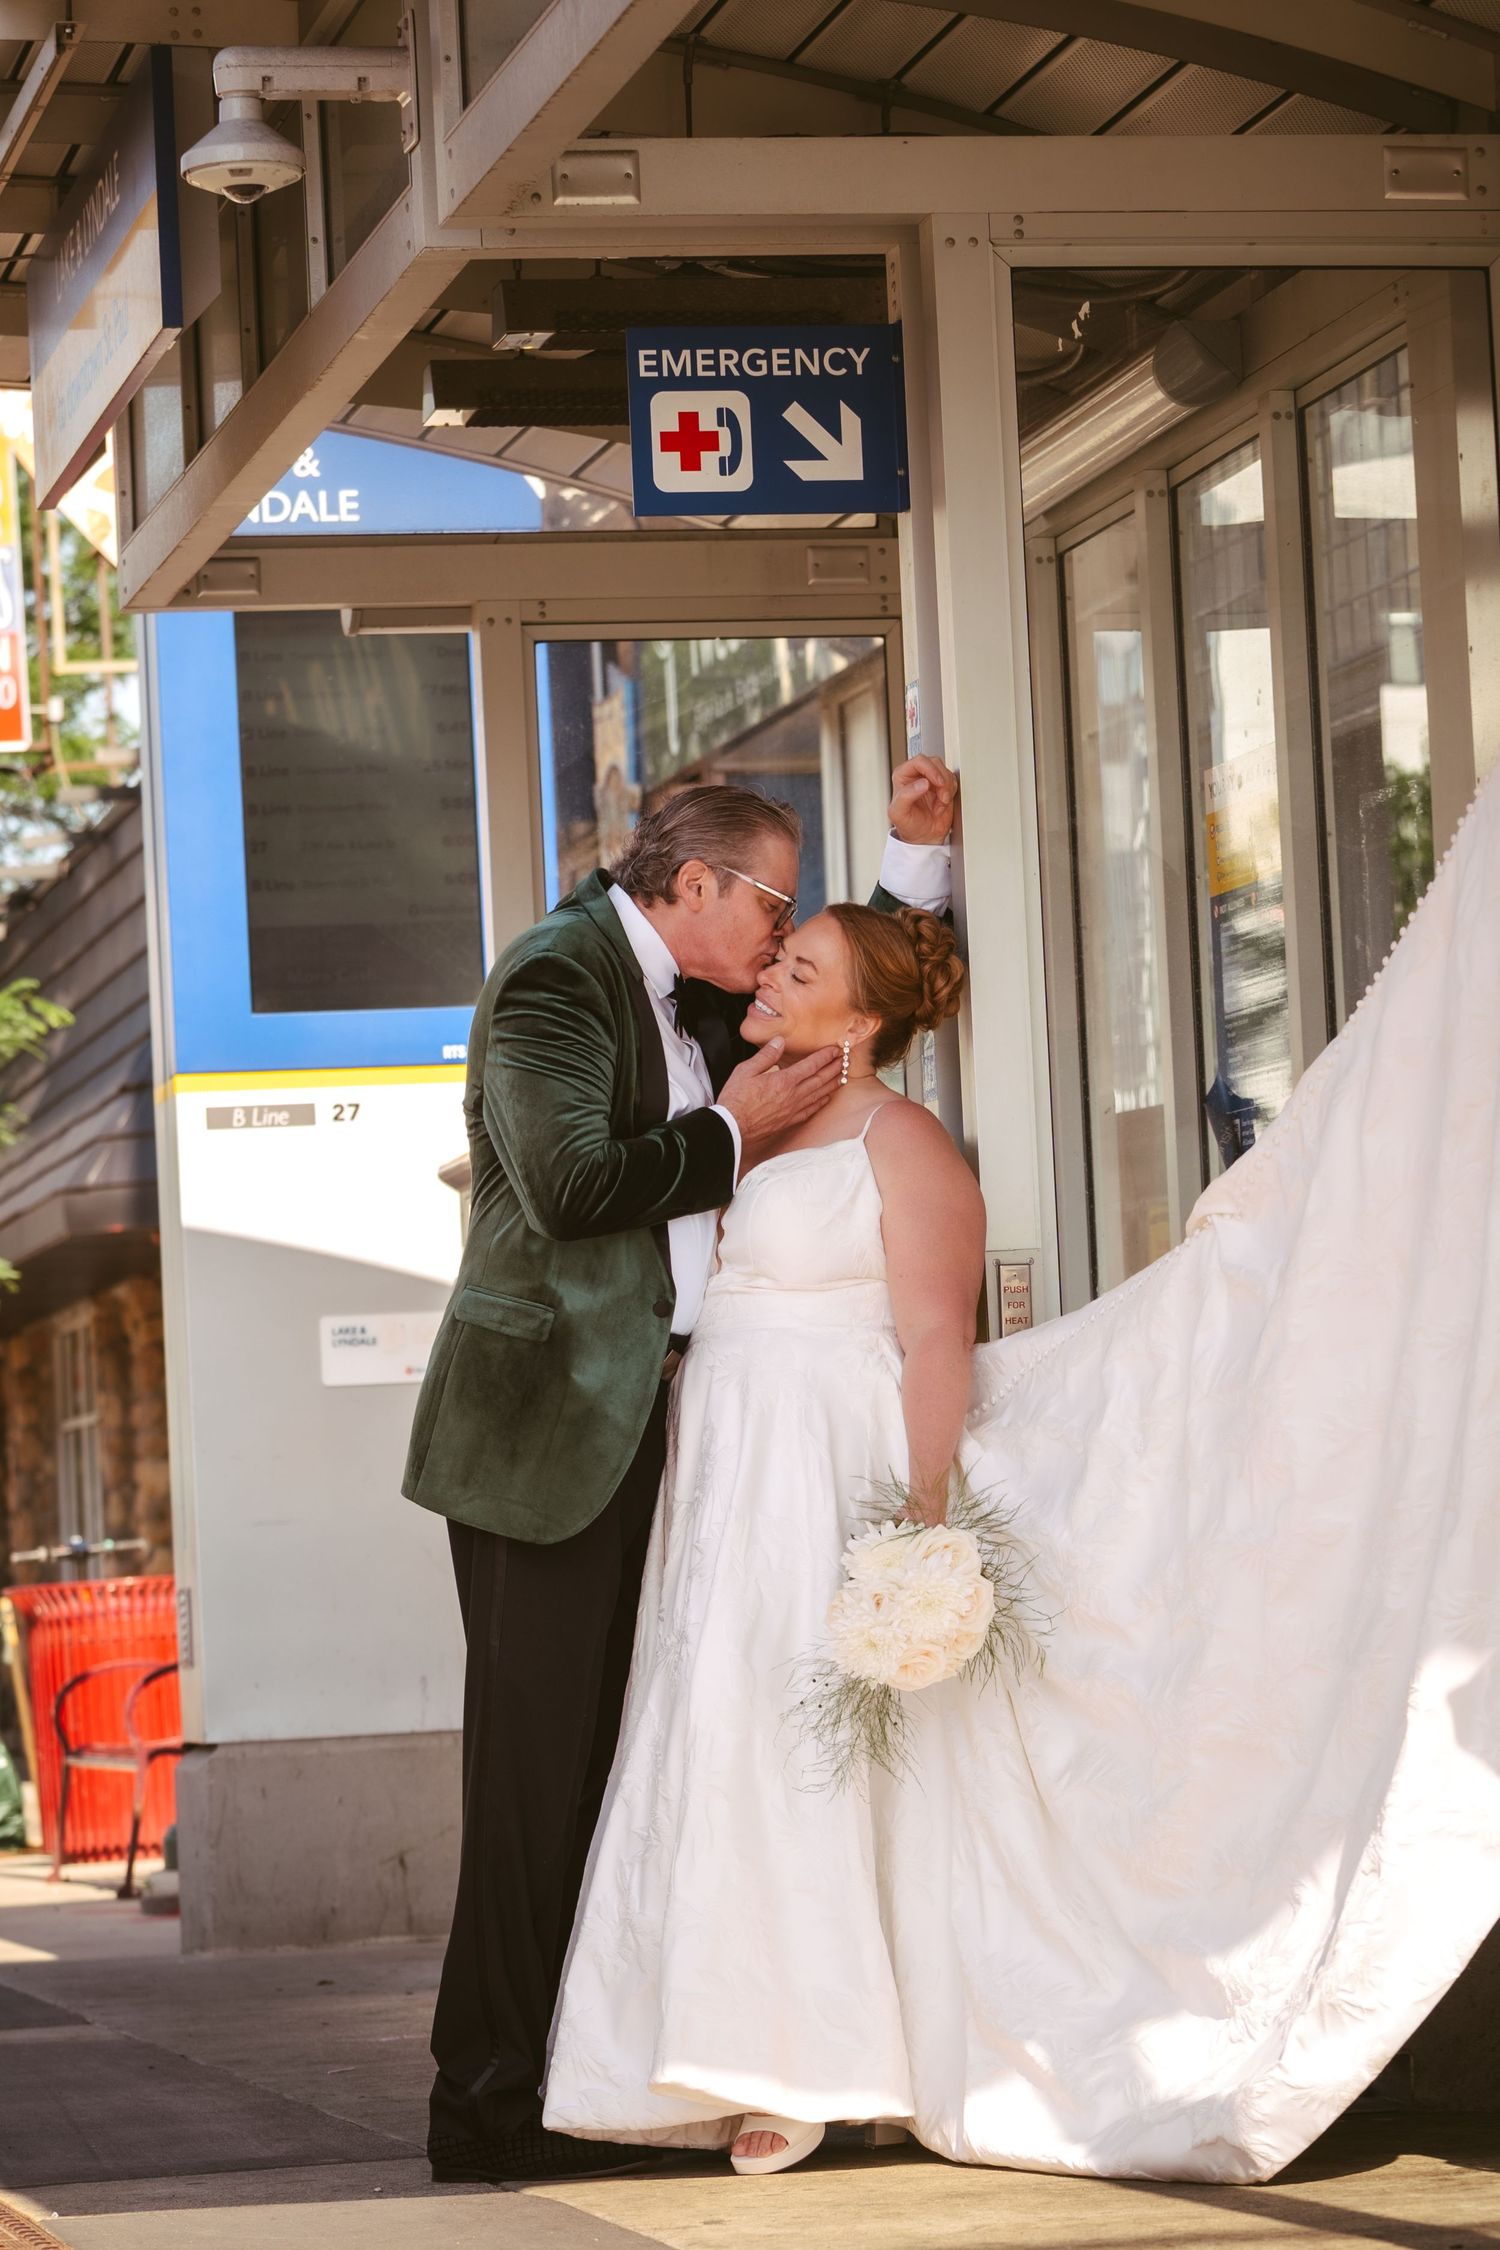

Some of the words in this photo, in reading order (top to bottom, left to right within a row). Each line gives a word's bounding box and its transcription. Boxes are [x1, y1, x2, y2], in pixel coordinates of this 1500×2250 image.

[54, 227, 77, 304] LAKE
[75, 219, 84, 269] &
[82, 150, 121, 258] LYNDALE
[638, 347, 870, 377] EMERGENCY
[293, 447, 321, 477] &
[232, 1108, 245, 1127] B
[252, 1106, 290, 1126] Line
[332, 1103, 360, 1122] 27
[1003, 1285, 1029, 1294] PUSH
[1007, 1301, 1026, 1309] FOR
[1005, 1316, 1029, 1325] HEAT
[331, 1327, 357, 1337] LAKE
[331, 1337, 377, 1348] LYNDALE
